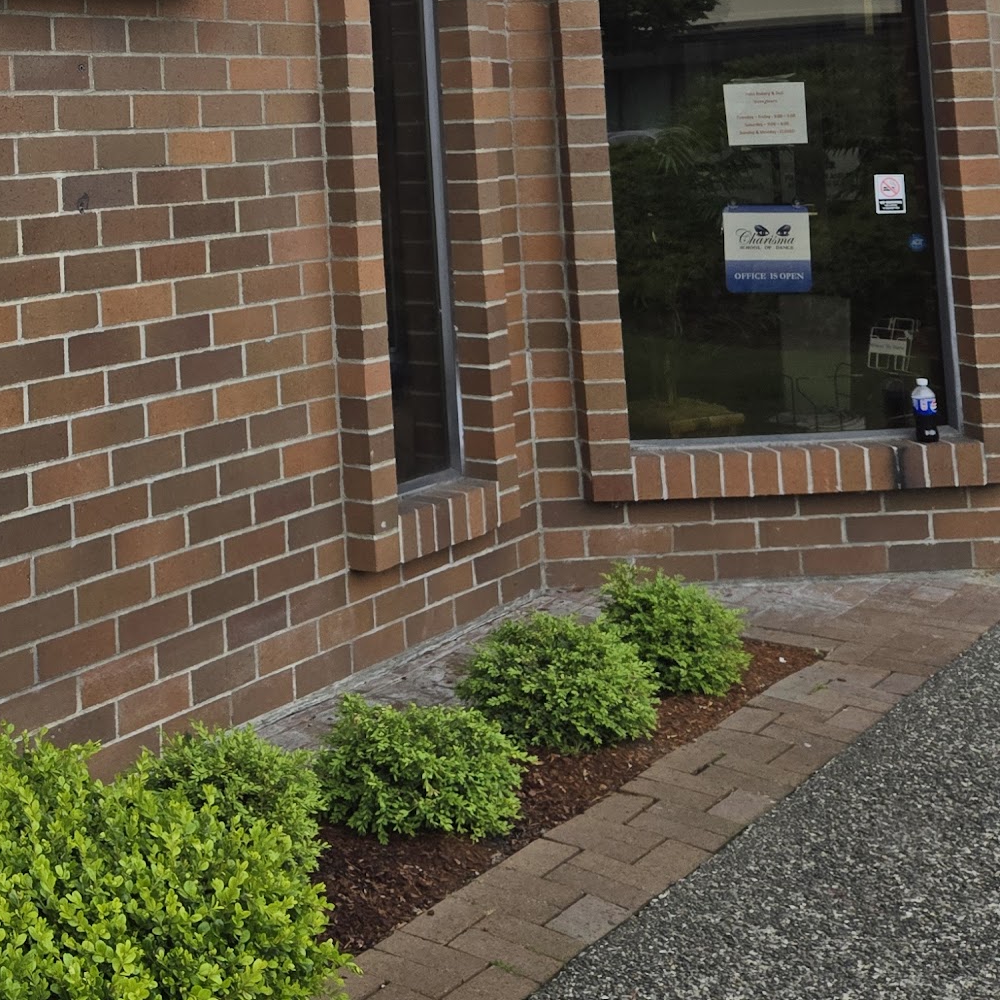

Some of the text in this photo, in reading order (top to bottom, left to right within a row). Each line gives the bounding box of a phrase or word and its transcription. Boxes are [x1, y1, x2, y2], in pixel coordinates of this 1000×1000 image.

[735, 228, 795, 245] Charisma
[734, 272, 804, 280] OFFICE IS OPEN
